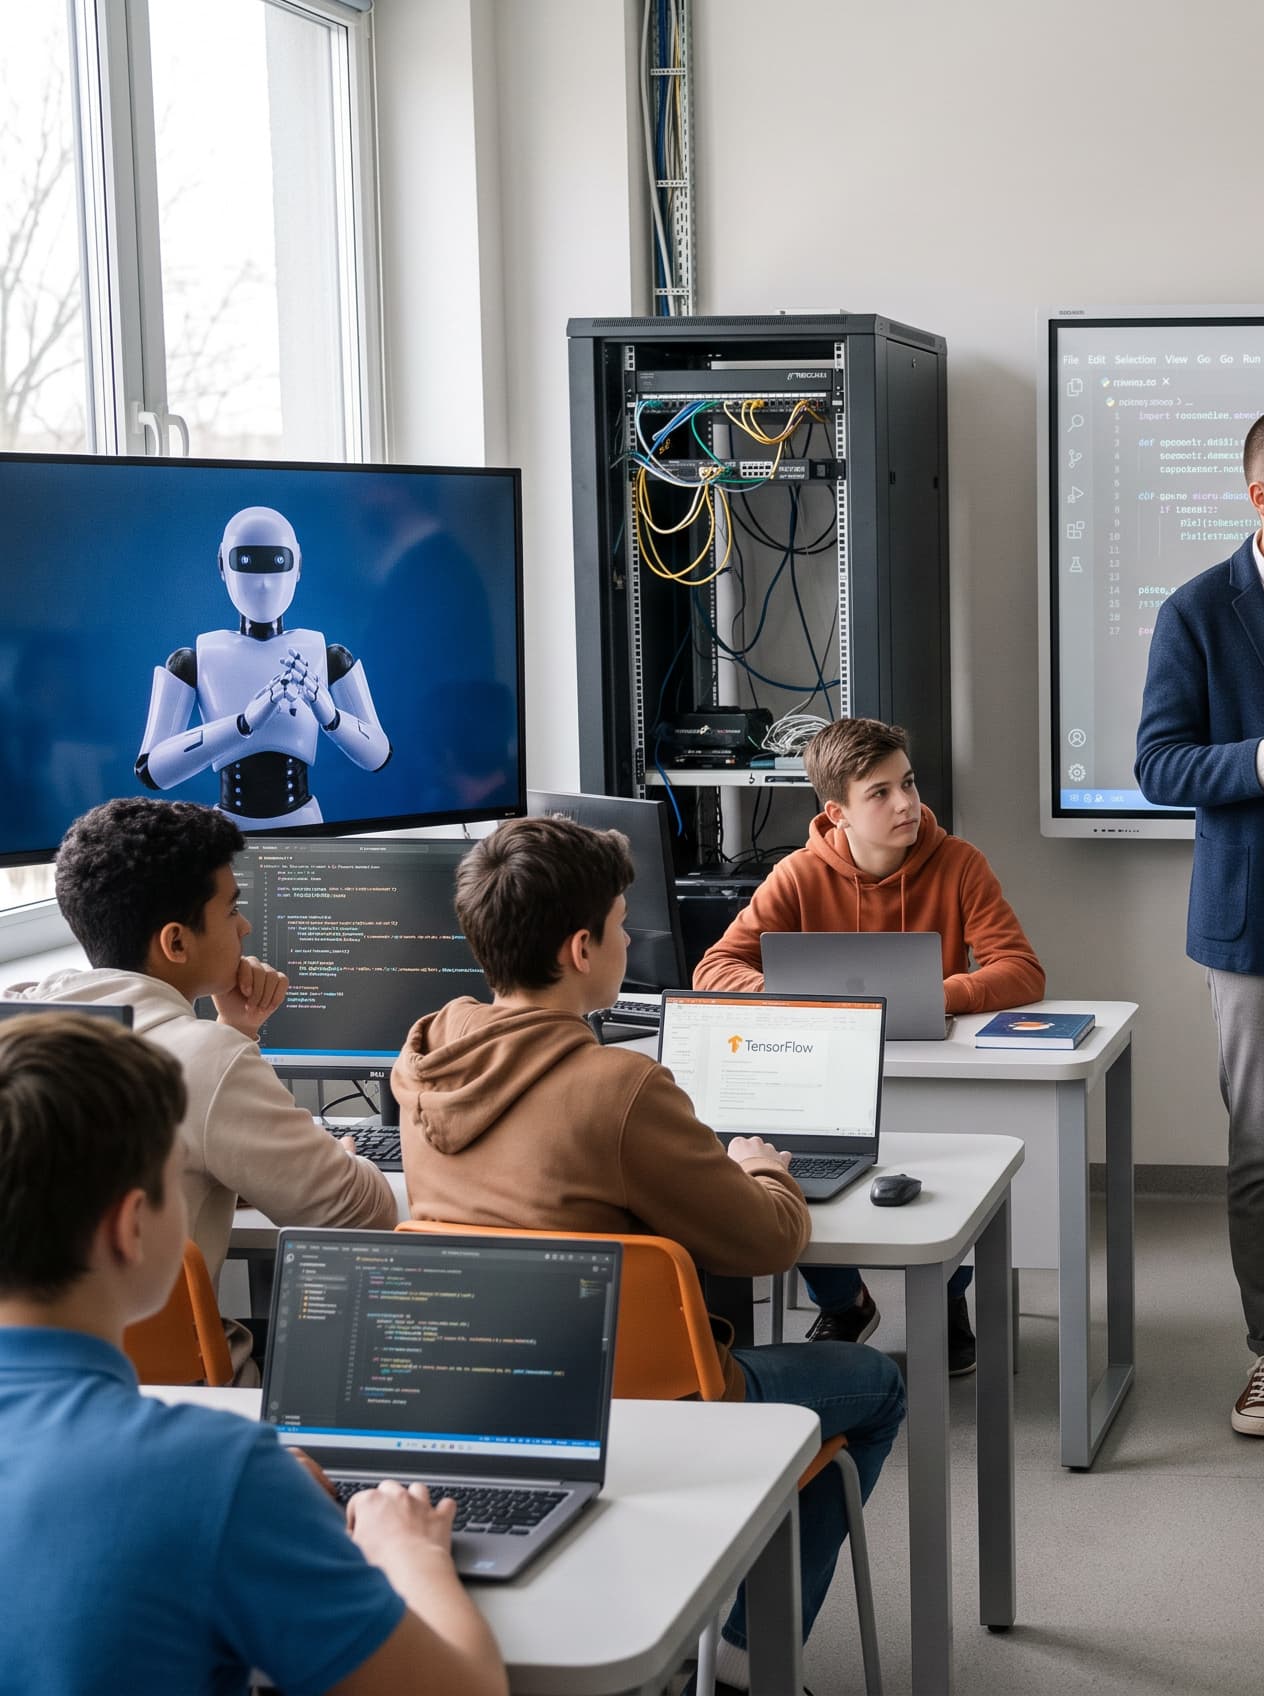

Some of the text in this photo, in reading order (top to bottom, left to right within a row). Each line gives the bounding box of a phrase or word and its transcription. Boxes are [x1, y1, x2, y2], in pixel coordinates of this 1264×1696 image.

[1063, 355, 1079, 364] File
[1088, 355, 1106, 364] Edit
[1114, 355, 1156, 364] Selection
[1165, 355, 1188, 364] View
[1197, 355, 1211, 364] Go
[1219, 354, 1233, 363] Go
[1242, 354, 1261, 363] Run
[745, 1040, 814, 1053] TensorFlow
